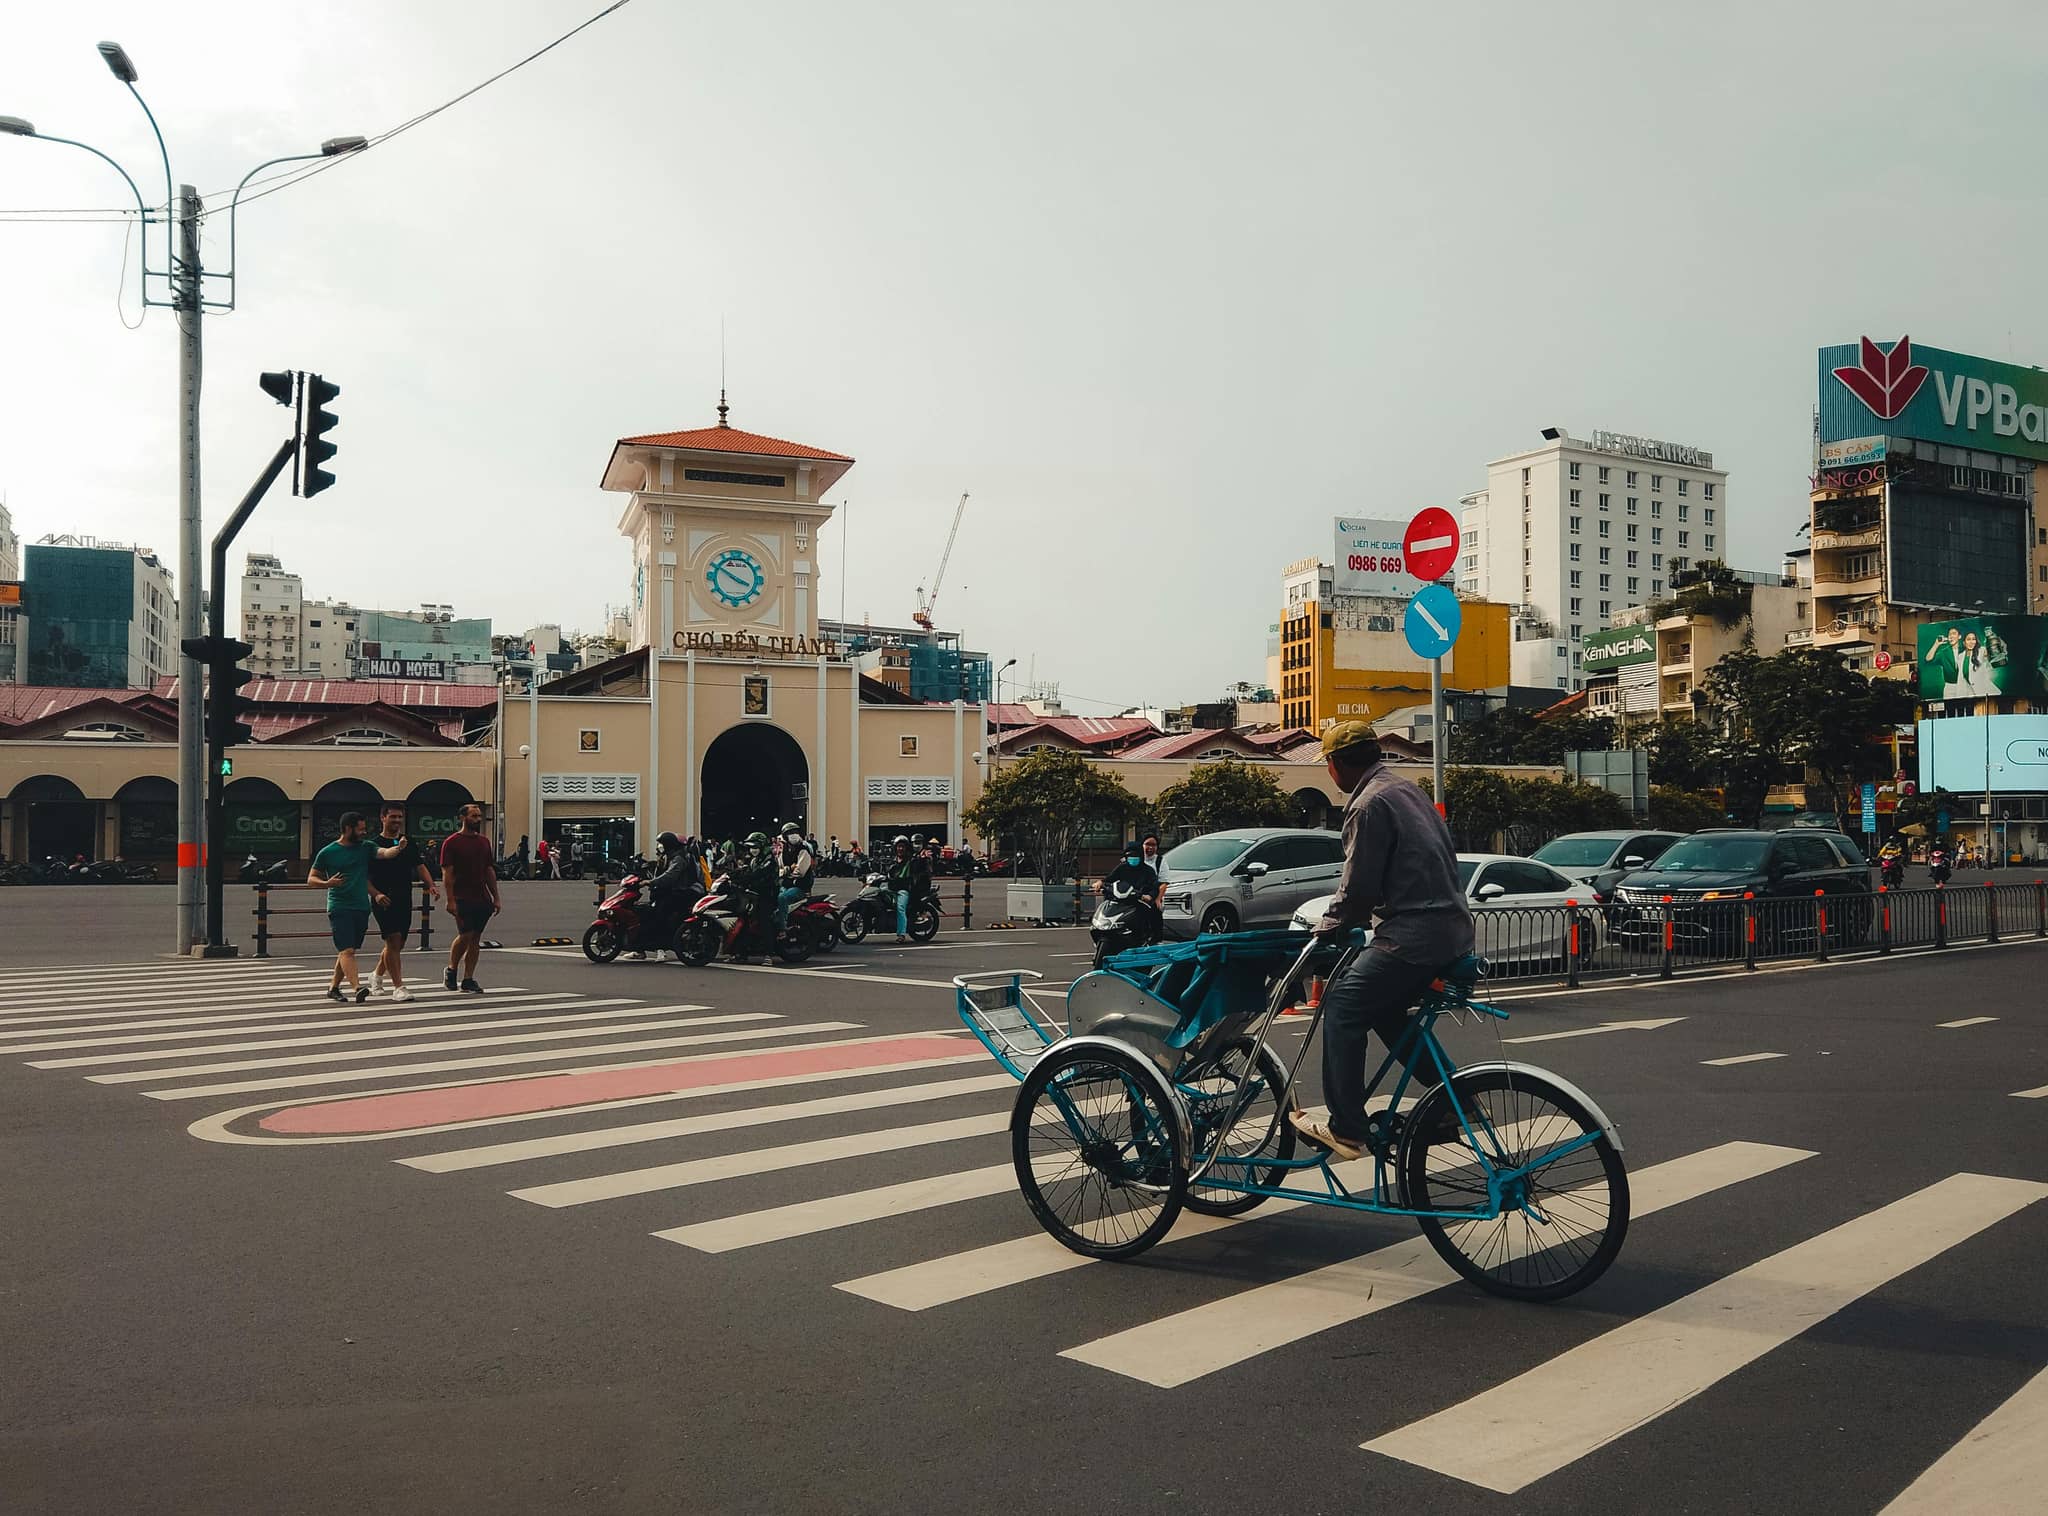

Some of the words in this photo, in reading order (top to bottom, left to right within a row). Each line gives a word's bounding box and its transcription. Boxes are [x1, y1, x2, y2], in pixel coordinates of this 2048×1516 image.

[1934, 369, 2048, 443] VPBa
[36, 533, 96, 547] AVANTI
[1348, 554, 1377, 572] 0986
[1380, 557, 1402, 573] 669
[672, 631, 714, 652] CHỢ
[767, 634, 837, 656] THÀNH
[370, 660, 401, 675] HALO
[406, 662, 443, 677] HOTEL
[236, 815, 287, 832] Grab
